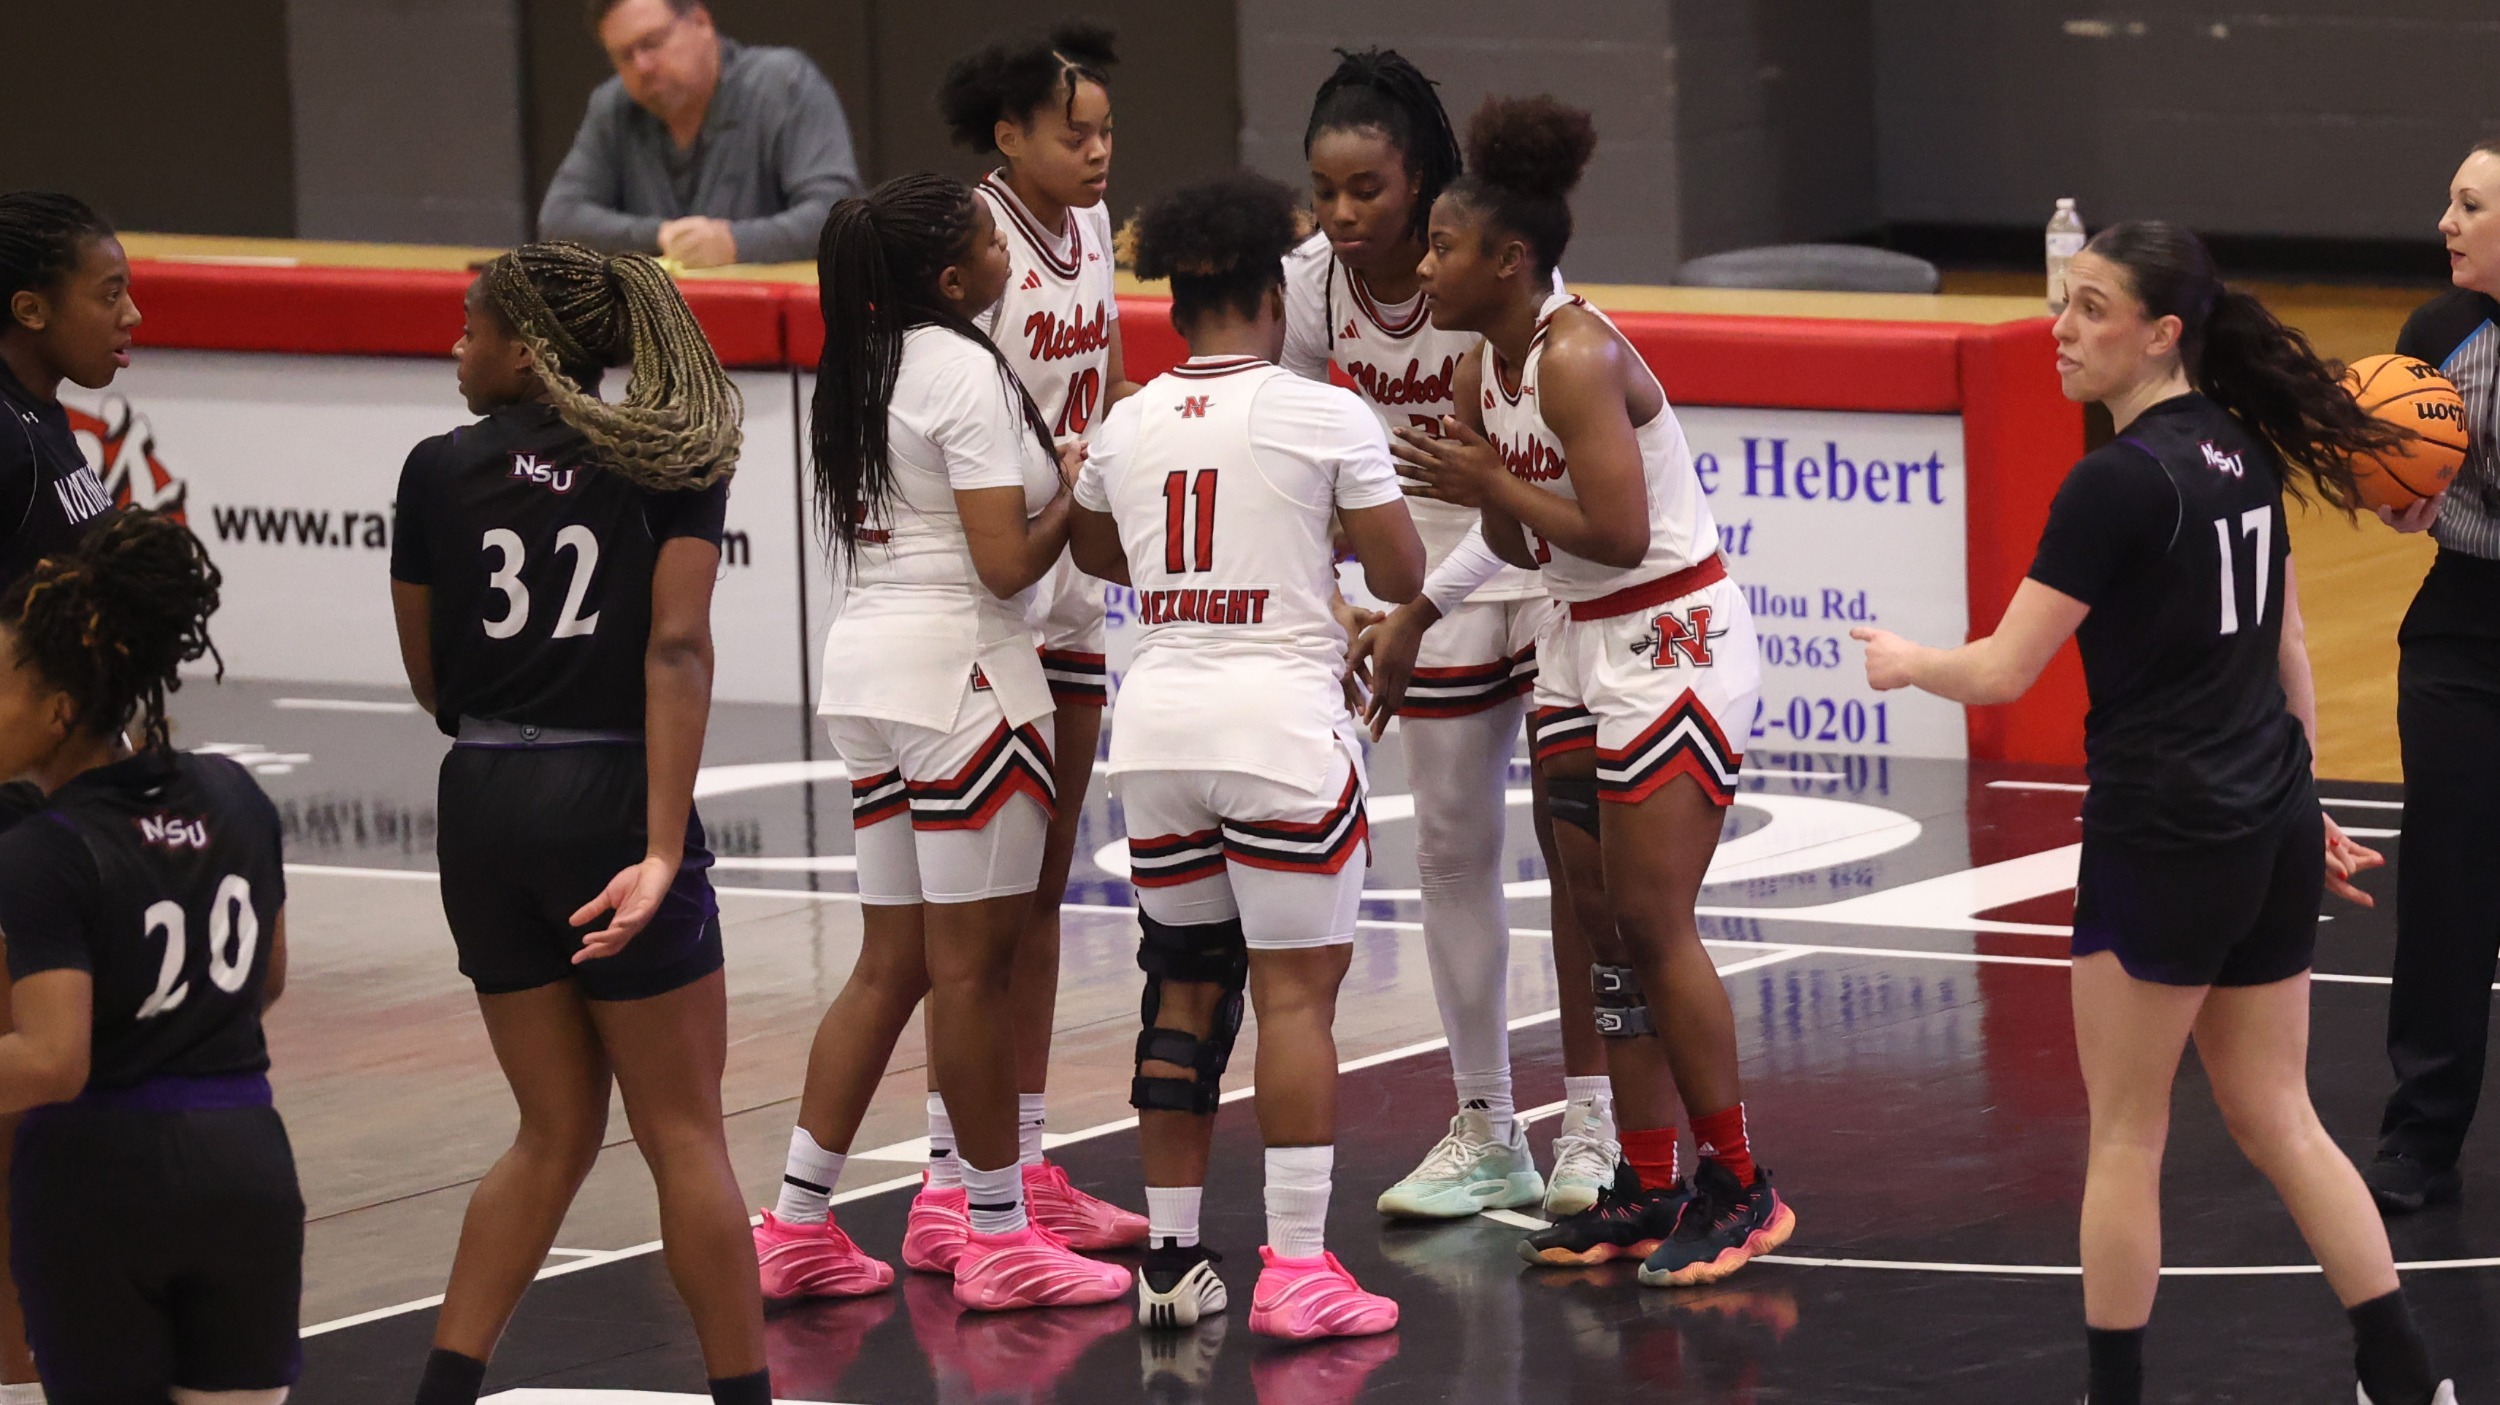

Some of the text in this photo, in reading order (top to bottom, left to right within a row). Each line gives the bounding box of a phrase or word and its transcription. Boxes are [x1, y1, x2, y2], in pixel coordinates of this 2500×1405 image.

[1024, 299, 1109, 361] Nichol
[1054, 367, 1099, 437] 10
[1348, 353, 1464, 405] Nichol
[512, 453, 575, 492] NSU
[1741, 437, 1946, 505] Hebert
[2200, 442, 2245, 478] NSU
[1162, 468, 1218, 574] 11
[481, 523, 600, 640] 32
[2213, 504, 2272, 636] 17
[1820, 587, 1878, 622] Rd.
[139, 816, 208, 849] NSU
[135, 873, 259, 1020] 20
